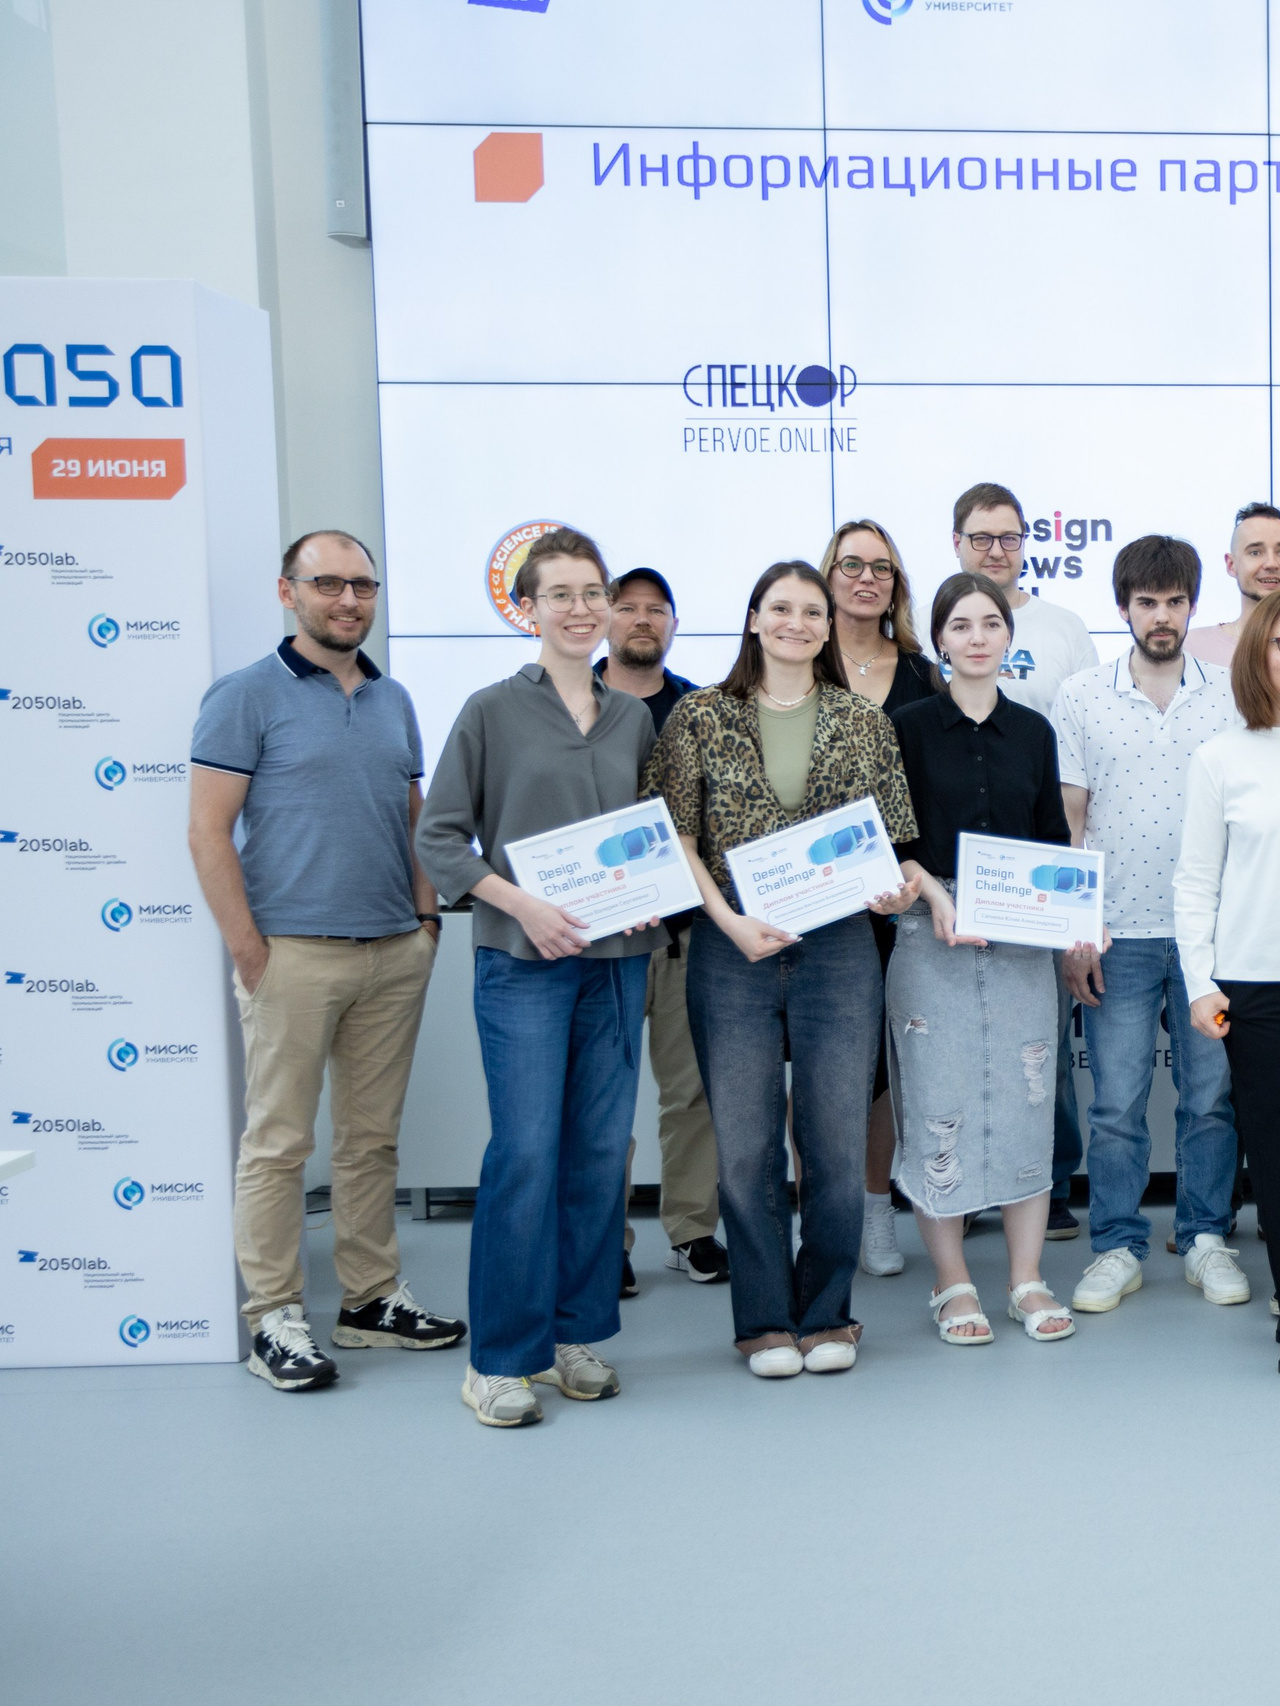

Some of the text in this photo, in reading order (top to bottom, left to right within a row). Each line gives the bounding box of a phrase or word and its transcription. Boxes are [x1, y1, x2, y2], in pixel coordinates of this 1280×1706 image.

[925, 1, 1014, 12] УНИВЕРСИТЕТ
[592, 141, 1138, 201] Информационные
[683, 427, 858, 453] PERVOE.ONLINE
[51, 459, 167, 478] 29 ИЮНЯ
[492, 525, 542, 571] SCIENCE
[4, 552, 79, 566] 2050lab.
[126, 620, 181, 632] МИСИС
[11, 696, 86, 710] 2050lab.
[132, 763, 187, 774] МИСИС
[19, 838, 93, 852] 2050lab.
[537, 861, 582, 882] Design
[752, 861, 794, 882] Design
[976, 865, 1015, 880] Design
[544, 869, 608, 897] Challenge
[756, 867, 816, 896] Challenge
[975, 880, 1032, 897] Challenge
[138, 904, 193, 915] МИСИС
[26, 979, 99, 993] 2050lab.
[144, 1044, 199, 1055] МИСИС
[32, 1119, 105, 1132] 2050lab.
[151, 1182, 204, 1193] МИСИС
[38, 1257, 111, 1271] 2050lab.
[156, 1319, 210, 1331] МИСИС
